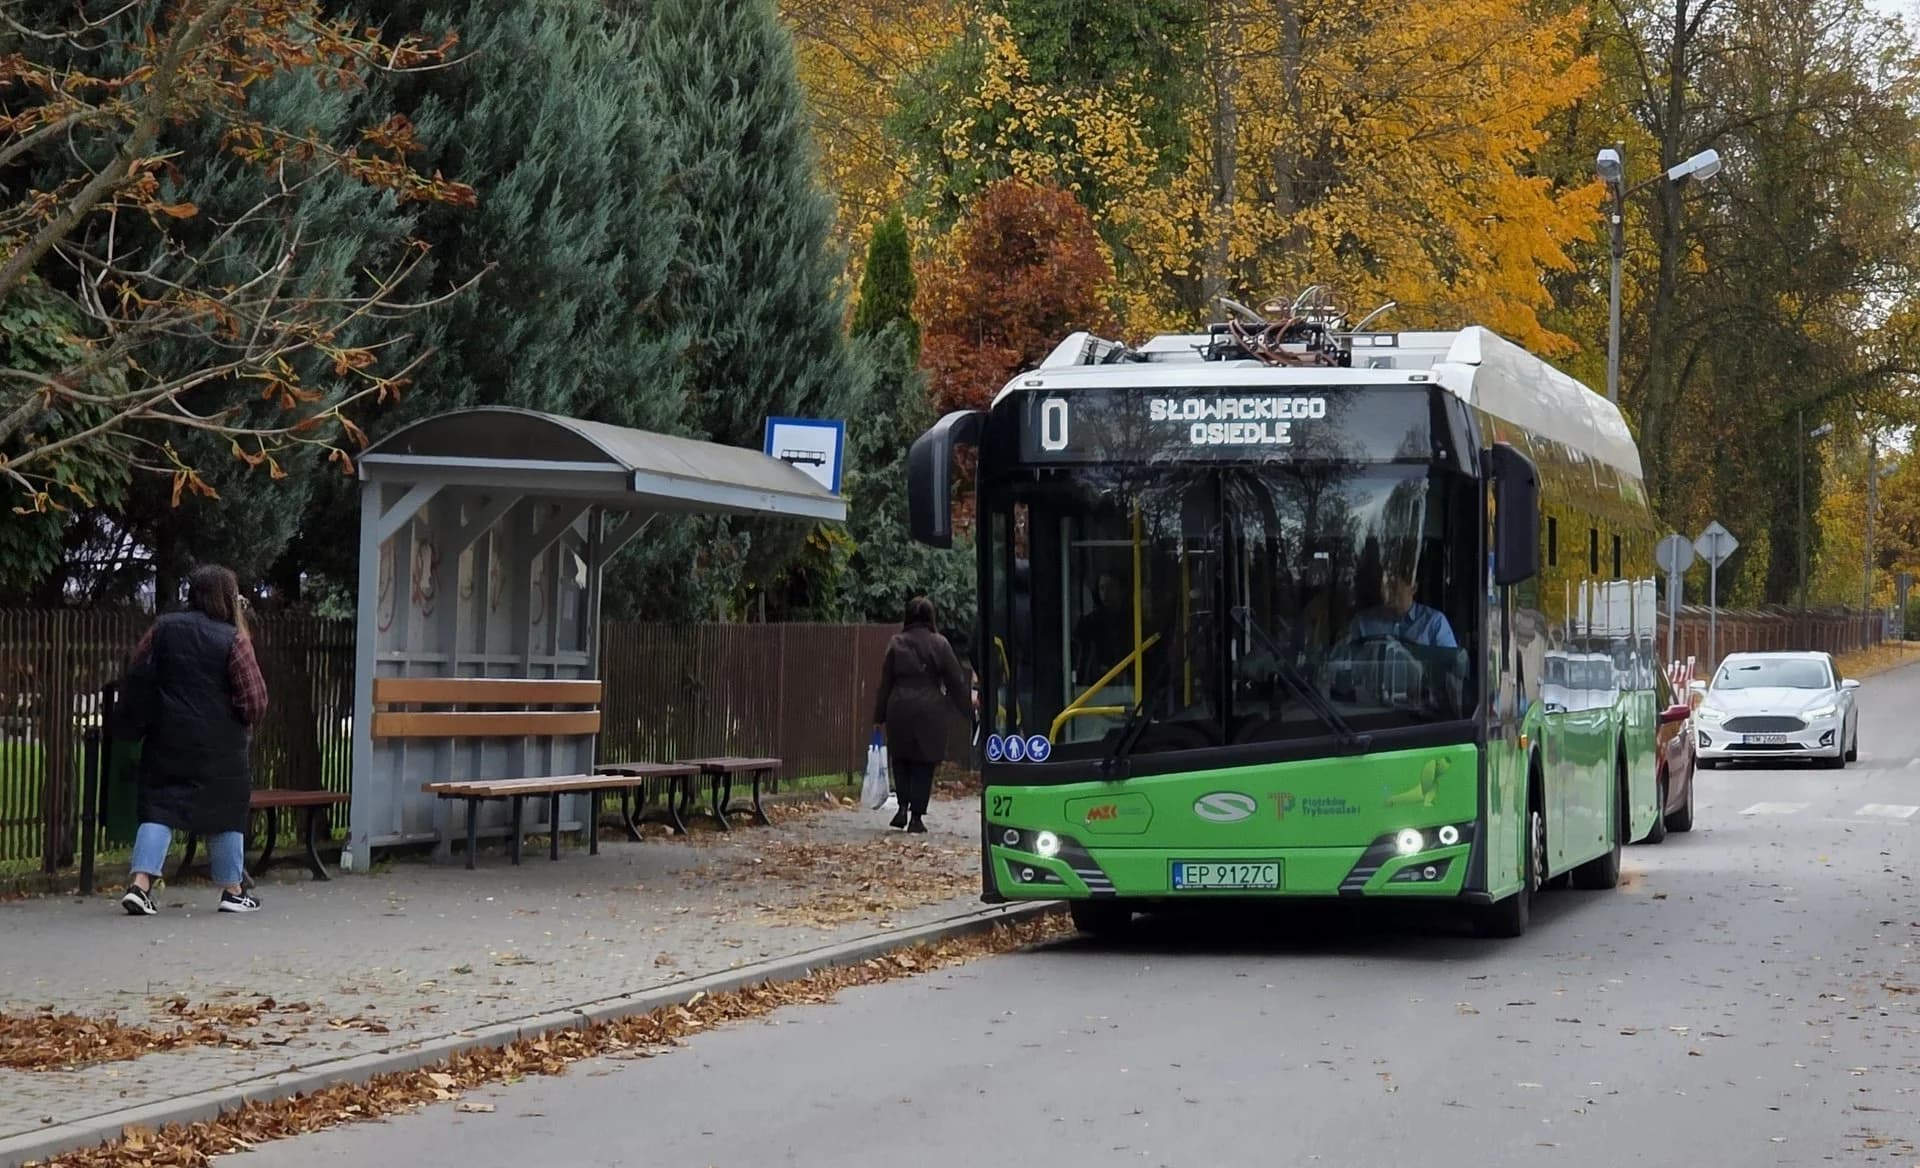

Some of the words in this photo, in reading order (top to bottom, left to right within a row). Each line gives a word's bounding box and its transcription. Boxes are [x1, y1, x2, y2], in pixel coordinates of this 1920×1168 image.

[1149, 397, 1326, 421] SŁOWACKIEGO
[1190, 421, 1292, 445] OSIEDLE
[993, 797, 1012, 817] 27
[1186, 866, 1210, 884] EP
[1217, 866, 1274, 884] 9127C
